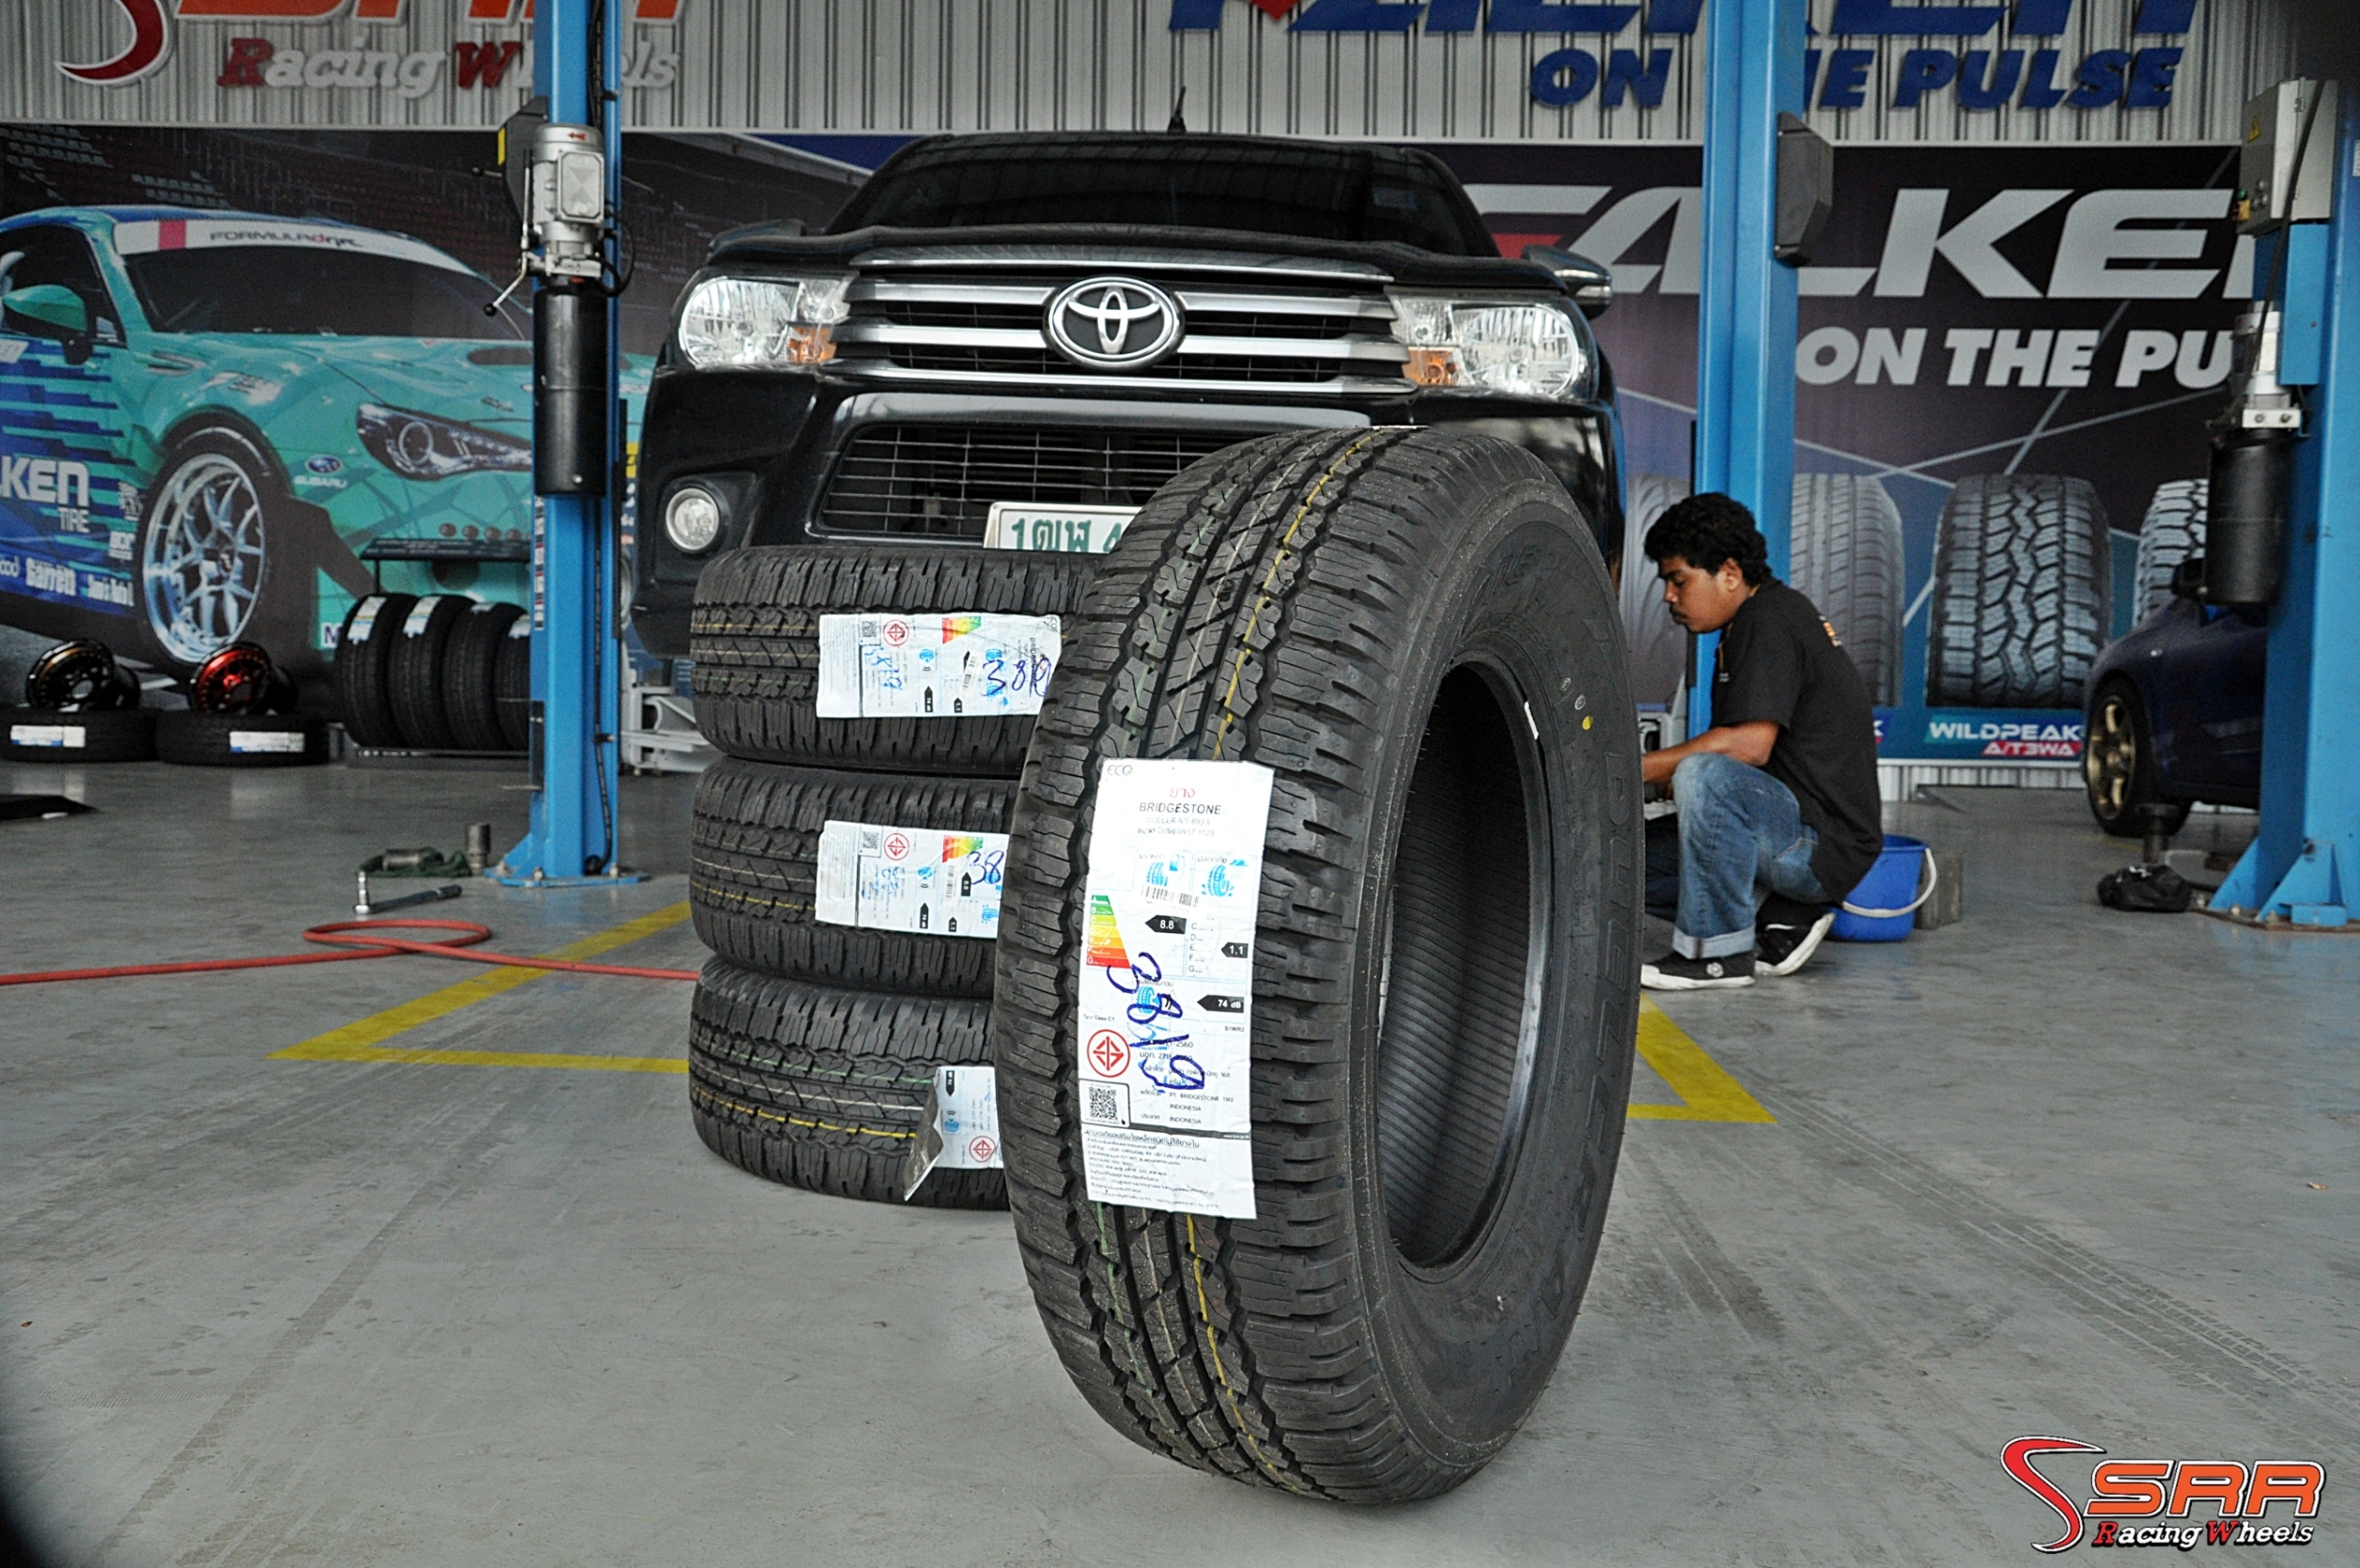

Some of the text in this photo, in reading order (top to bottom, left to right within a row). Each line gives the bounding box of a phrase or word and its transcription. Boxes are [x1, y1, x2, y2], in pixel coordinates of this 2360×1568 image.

[217, 34, 449, 99] Racing
[1529, 47, 1673, 109] ON
[1892, 46, 2187, 109] PULSE
[1796, 325, 1926, 387] ON
[1944, 327, 2101, 388] THE
[294, 475, 349, 489] SUBARU
[57, 506, 90, 534] TIRE
[1929, 722, 2082, 741] WILDPEAK
[1139, 801, 1221, 815] BRIDGESTONE
[1191, 817, 1204, 826] 693
[1159, 919, 1174, 930] 8.8
[1229, 944, 1244, 955] 1.1
[1217, 1000, 1242, 1010] 74 dB
[1180, 1093, 1219, 1102] BRIDGESTONE
[1170, 1103, 1202, 1112] INDONESIA
[1170, 1116, 1202, 1126] INDONESIA
